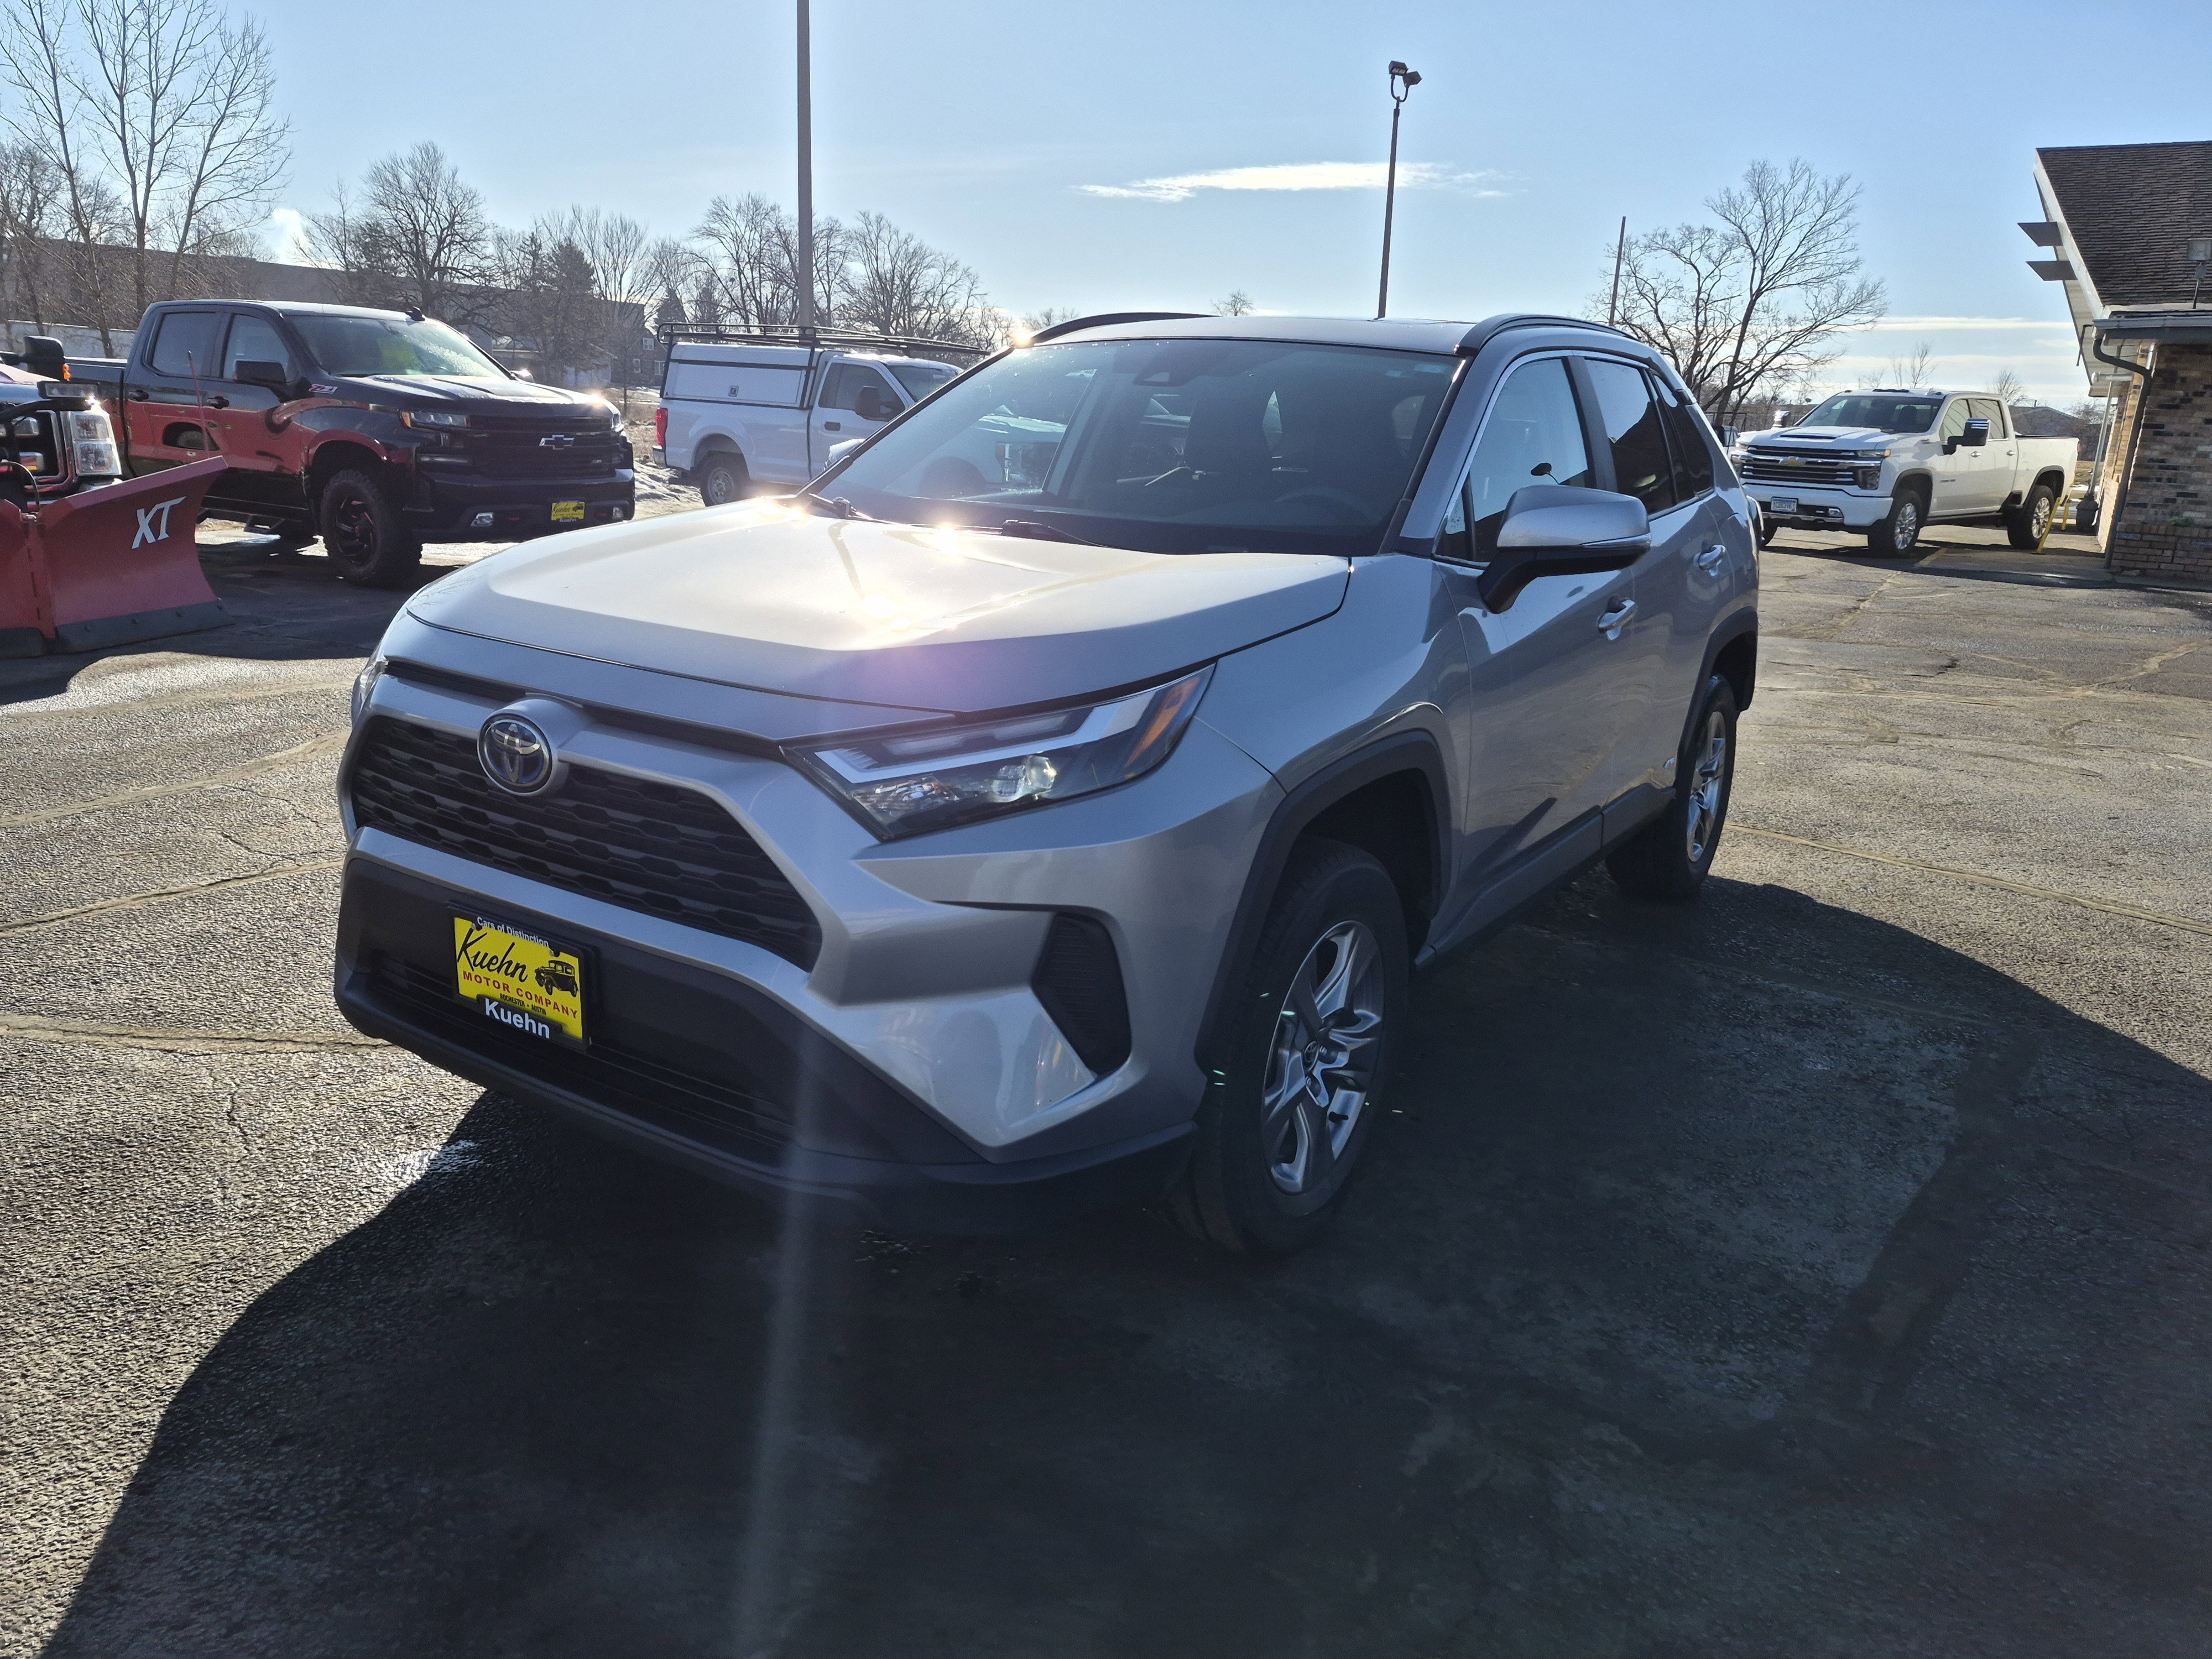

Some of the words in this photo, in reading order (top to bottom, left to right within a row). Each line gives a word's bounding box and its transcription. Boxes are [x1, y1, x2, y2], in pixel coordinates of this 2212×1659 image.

[131, 495, 187, 550] XT
[457, 927, 529, 983] Kuehn
[477, 916, 495, 931] Cars
[497, 924, 505, 933] of
[506, 926, 550, 948] Distinction
[462, 970, 511, 993] MOTOR
[516, 987, 578, 1019] COMPANY
[499, 993, 526, 1008] ROCHESTER
[531, 1003, 547, 1016] AUSTIN
[484, 997, 551, 1040] Kuehn
